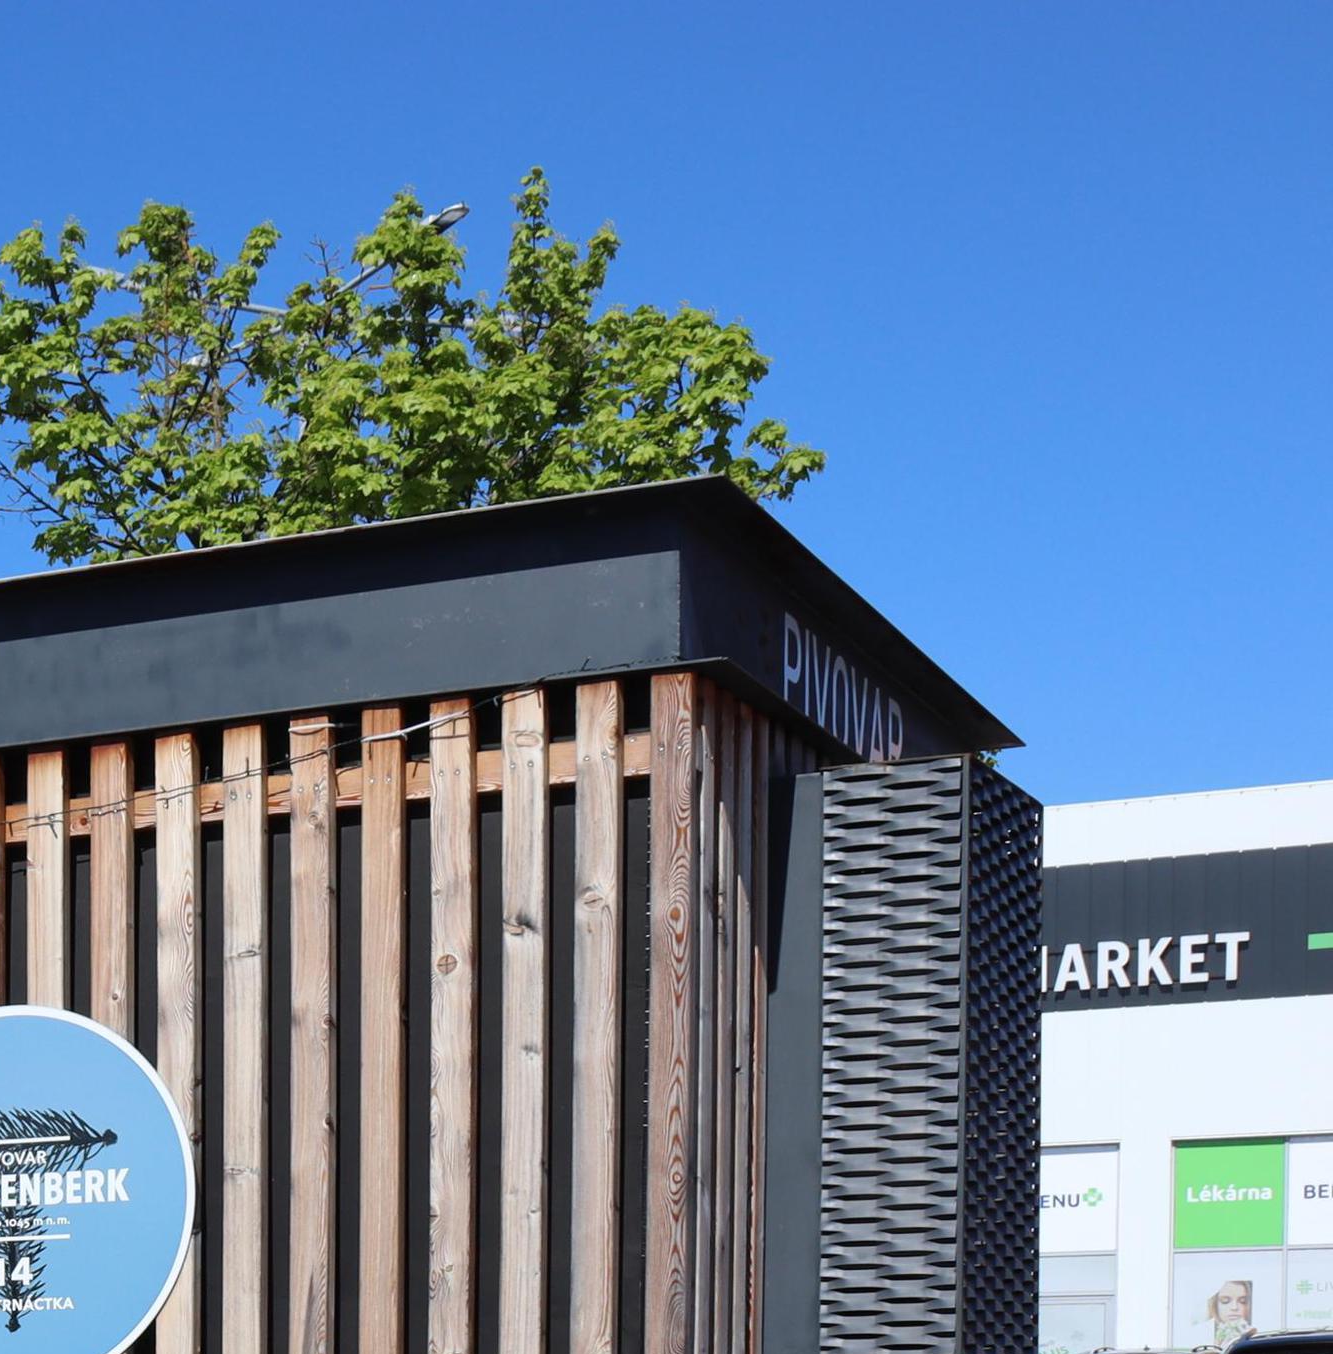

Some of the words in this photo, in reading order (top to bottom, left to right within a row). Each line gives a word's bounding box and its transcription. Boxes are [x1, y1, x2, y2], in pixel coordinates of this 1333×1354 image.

[784, 611, 903, 763] PIVOVAR
[1041, 931, 1250, 993] ARKET
[1187, 1183, 1273, 1203] Lékárna
[1304, 1184, 1333, 1199] BE
[5, 1218, 31, 1229] 1045
